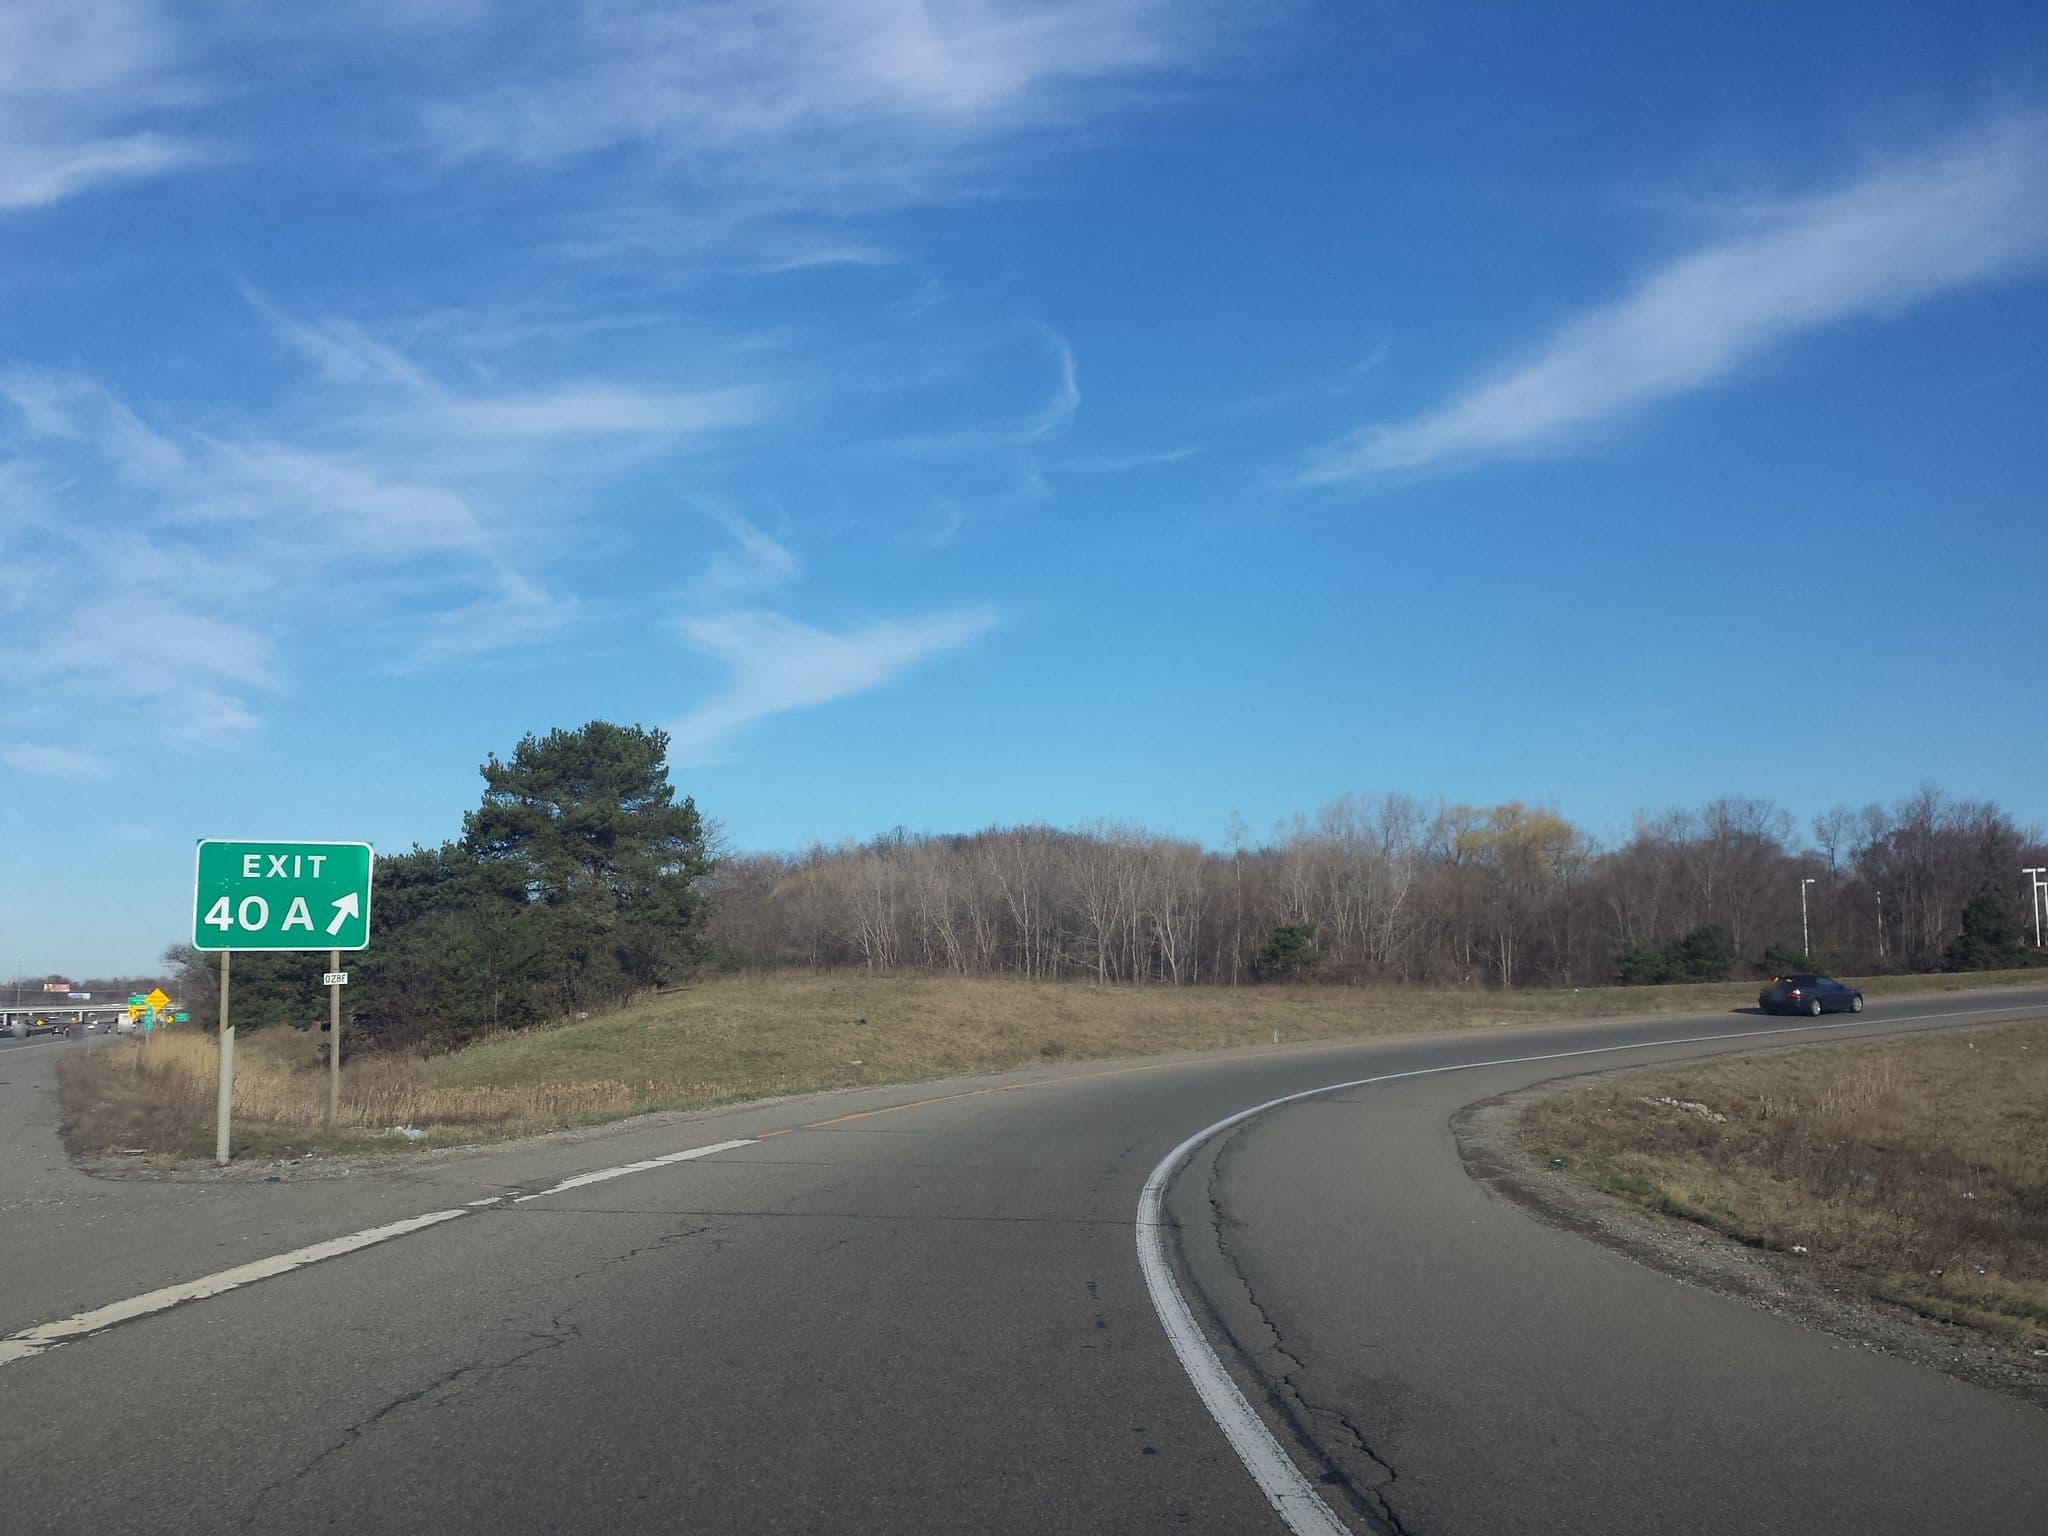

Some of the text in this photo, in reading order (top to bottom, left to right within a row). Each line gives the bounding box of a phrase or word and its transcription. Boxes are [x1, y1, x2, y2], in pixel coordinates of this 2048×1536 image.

[242, 854, 327, 879] EXIT
[204, 895, 315, 932] 40 A
